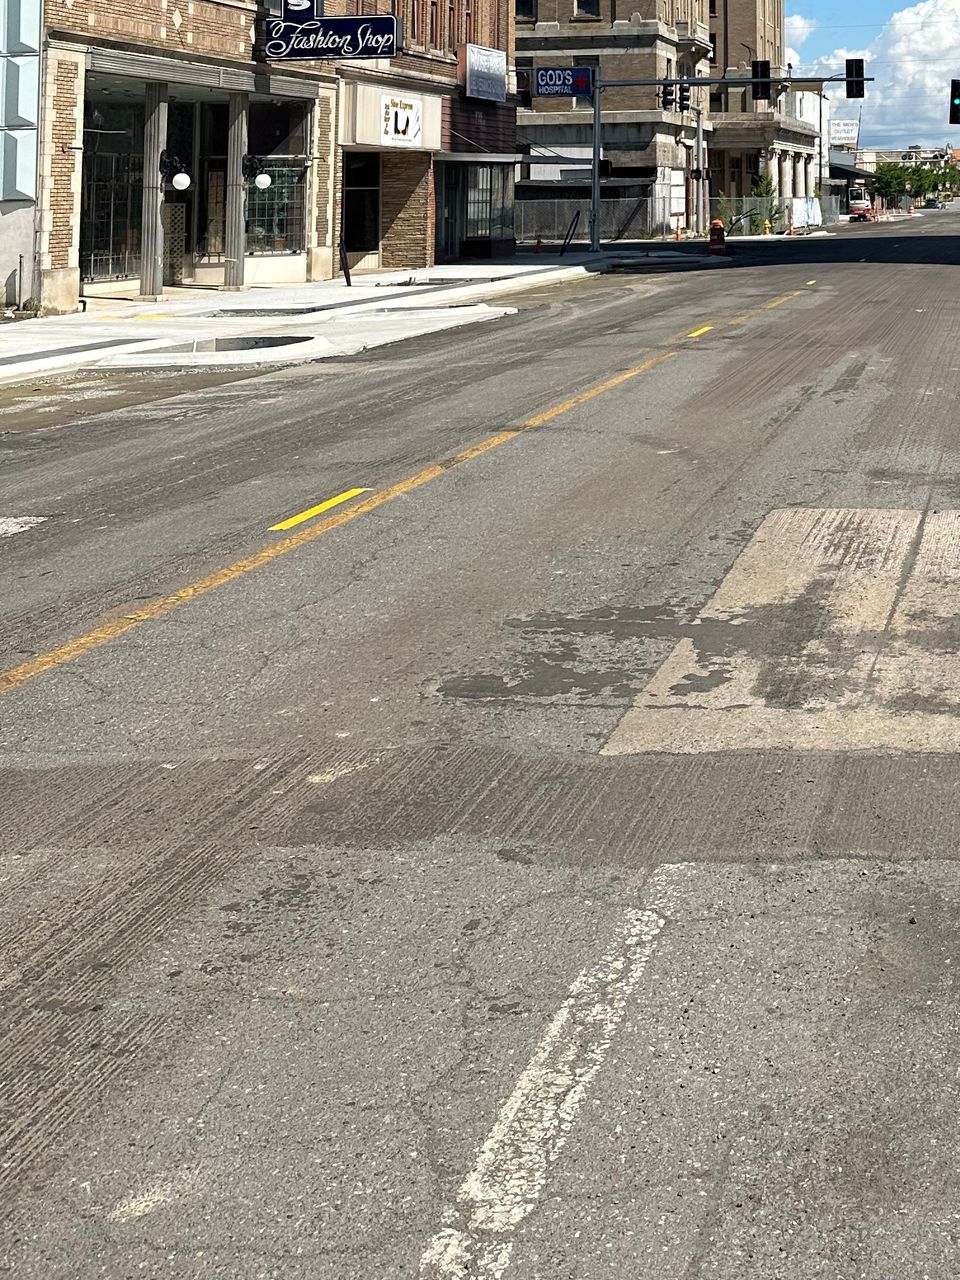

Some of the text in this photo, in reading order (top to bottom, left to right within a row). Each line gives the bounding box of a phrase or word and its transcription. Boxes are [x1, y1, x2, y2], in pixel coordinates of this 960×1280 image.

[265, 21, 394, 55] Fashion Shop
[537, 70, 573, 86] GOD'S
[538, 85, 573, 94] HOSPITAL
